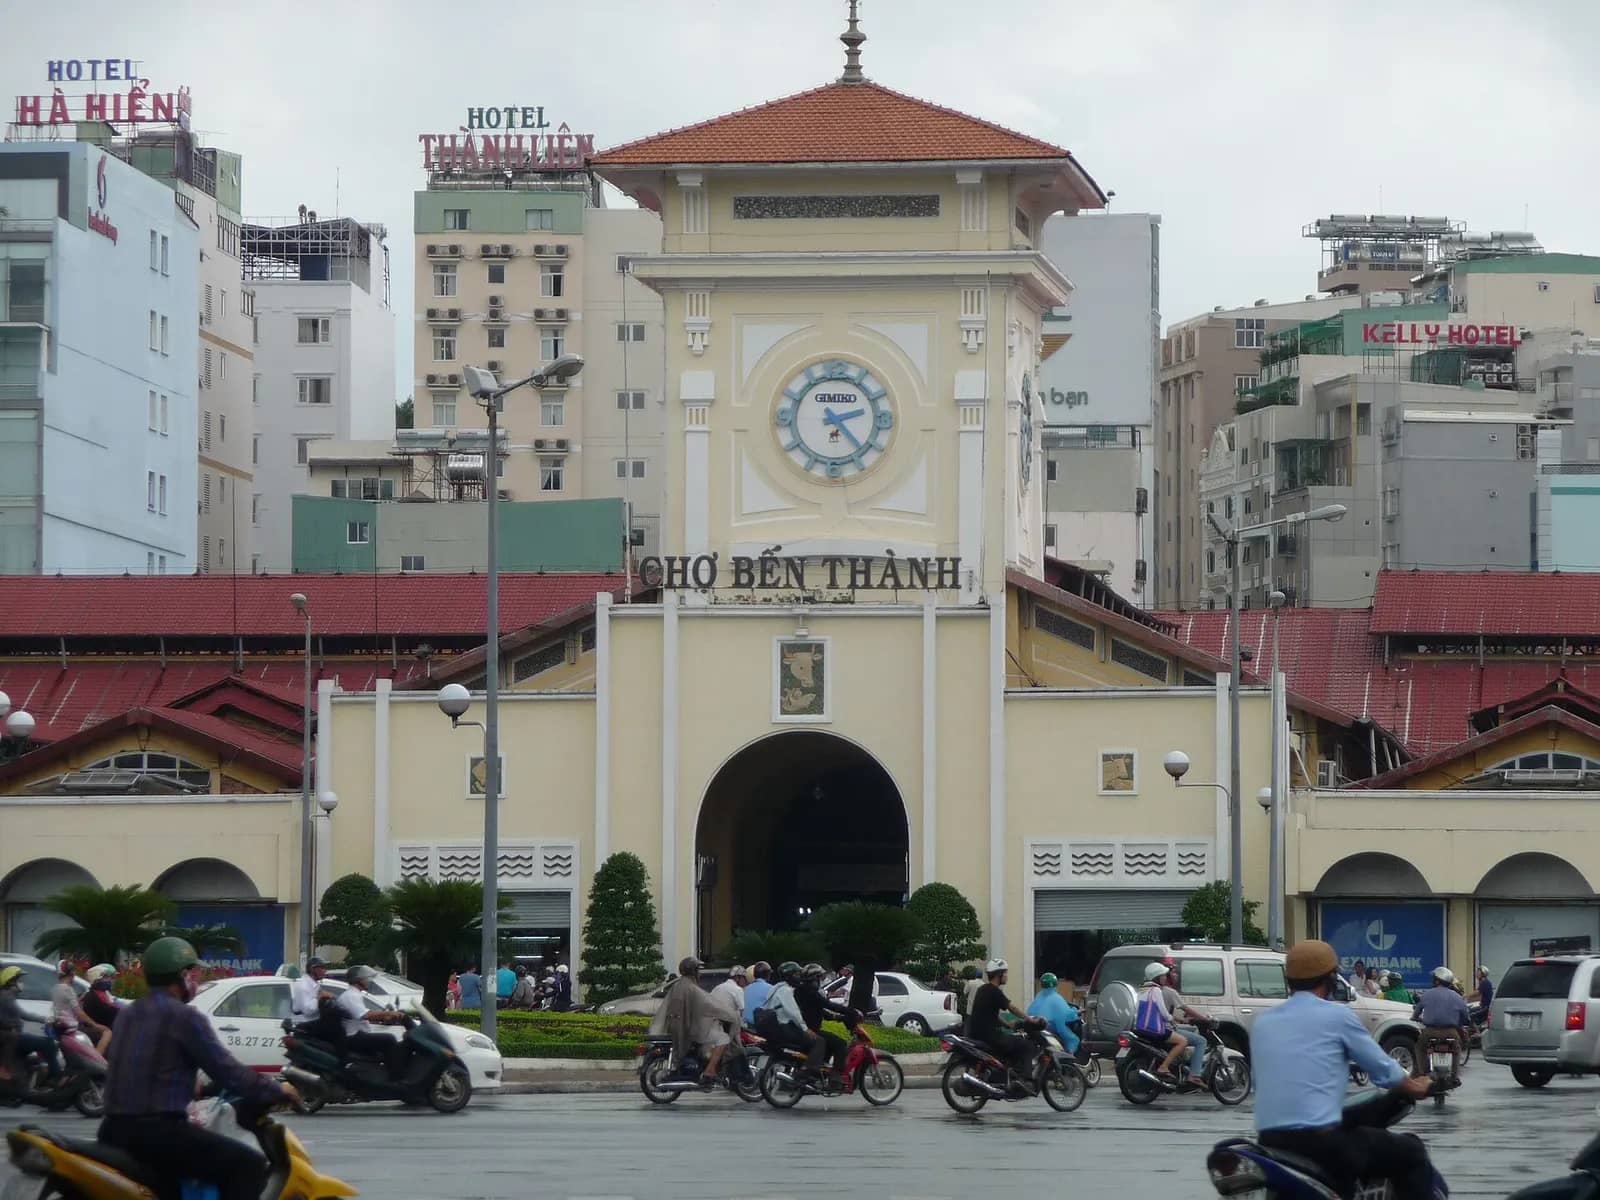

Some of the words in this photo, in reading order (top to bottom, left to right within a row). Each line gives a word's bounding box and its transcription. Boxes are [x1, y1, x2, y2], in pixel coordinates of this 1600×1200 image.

[48, 59, 138, 81] HOTEL
[20, 87, 71, 125] HÀ
[86, 78, 174, 122] HIỂN
[467, 106, 550, 129] HOTEL
[1363, 323, 1440, 344] KELLY
[1448, 324, 1522, 346] HOTEL
[1050, 386, 1089, 410] bạn
[639, 551, 719, 594] CHỢ
[731, 544, 807, 590] BẾN
[821, 549, 963, 590] THÀNH
[261, 1037, 274, 1048] 27
